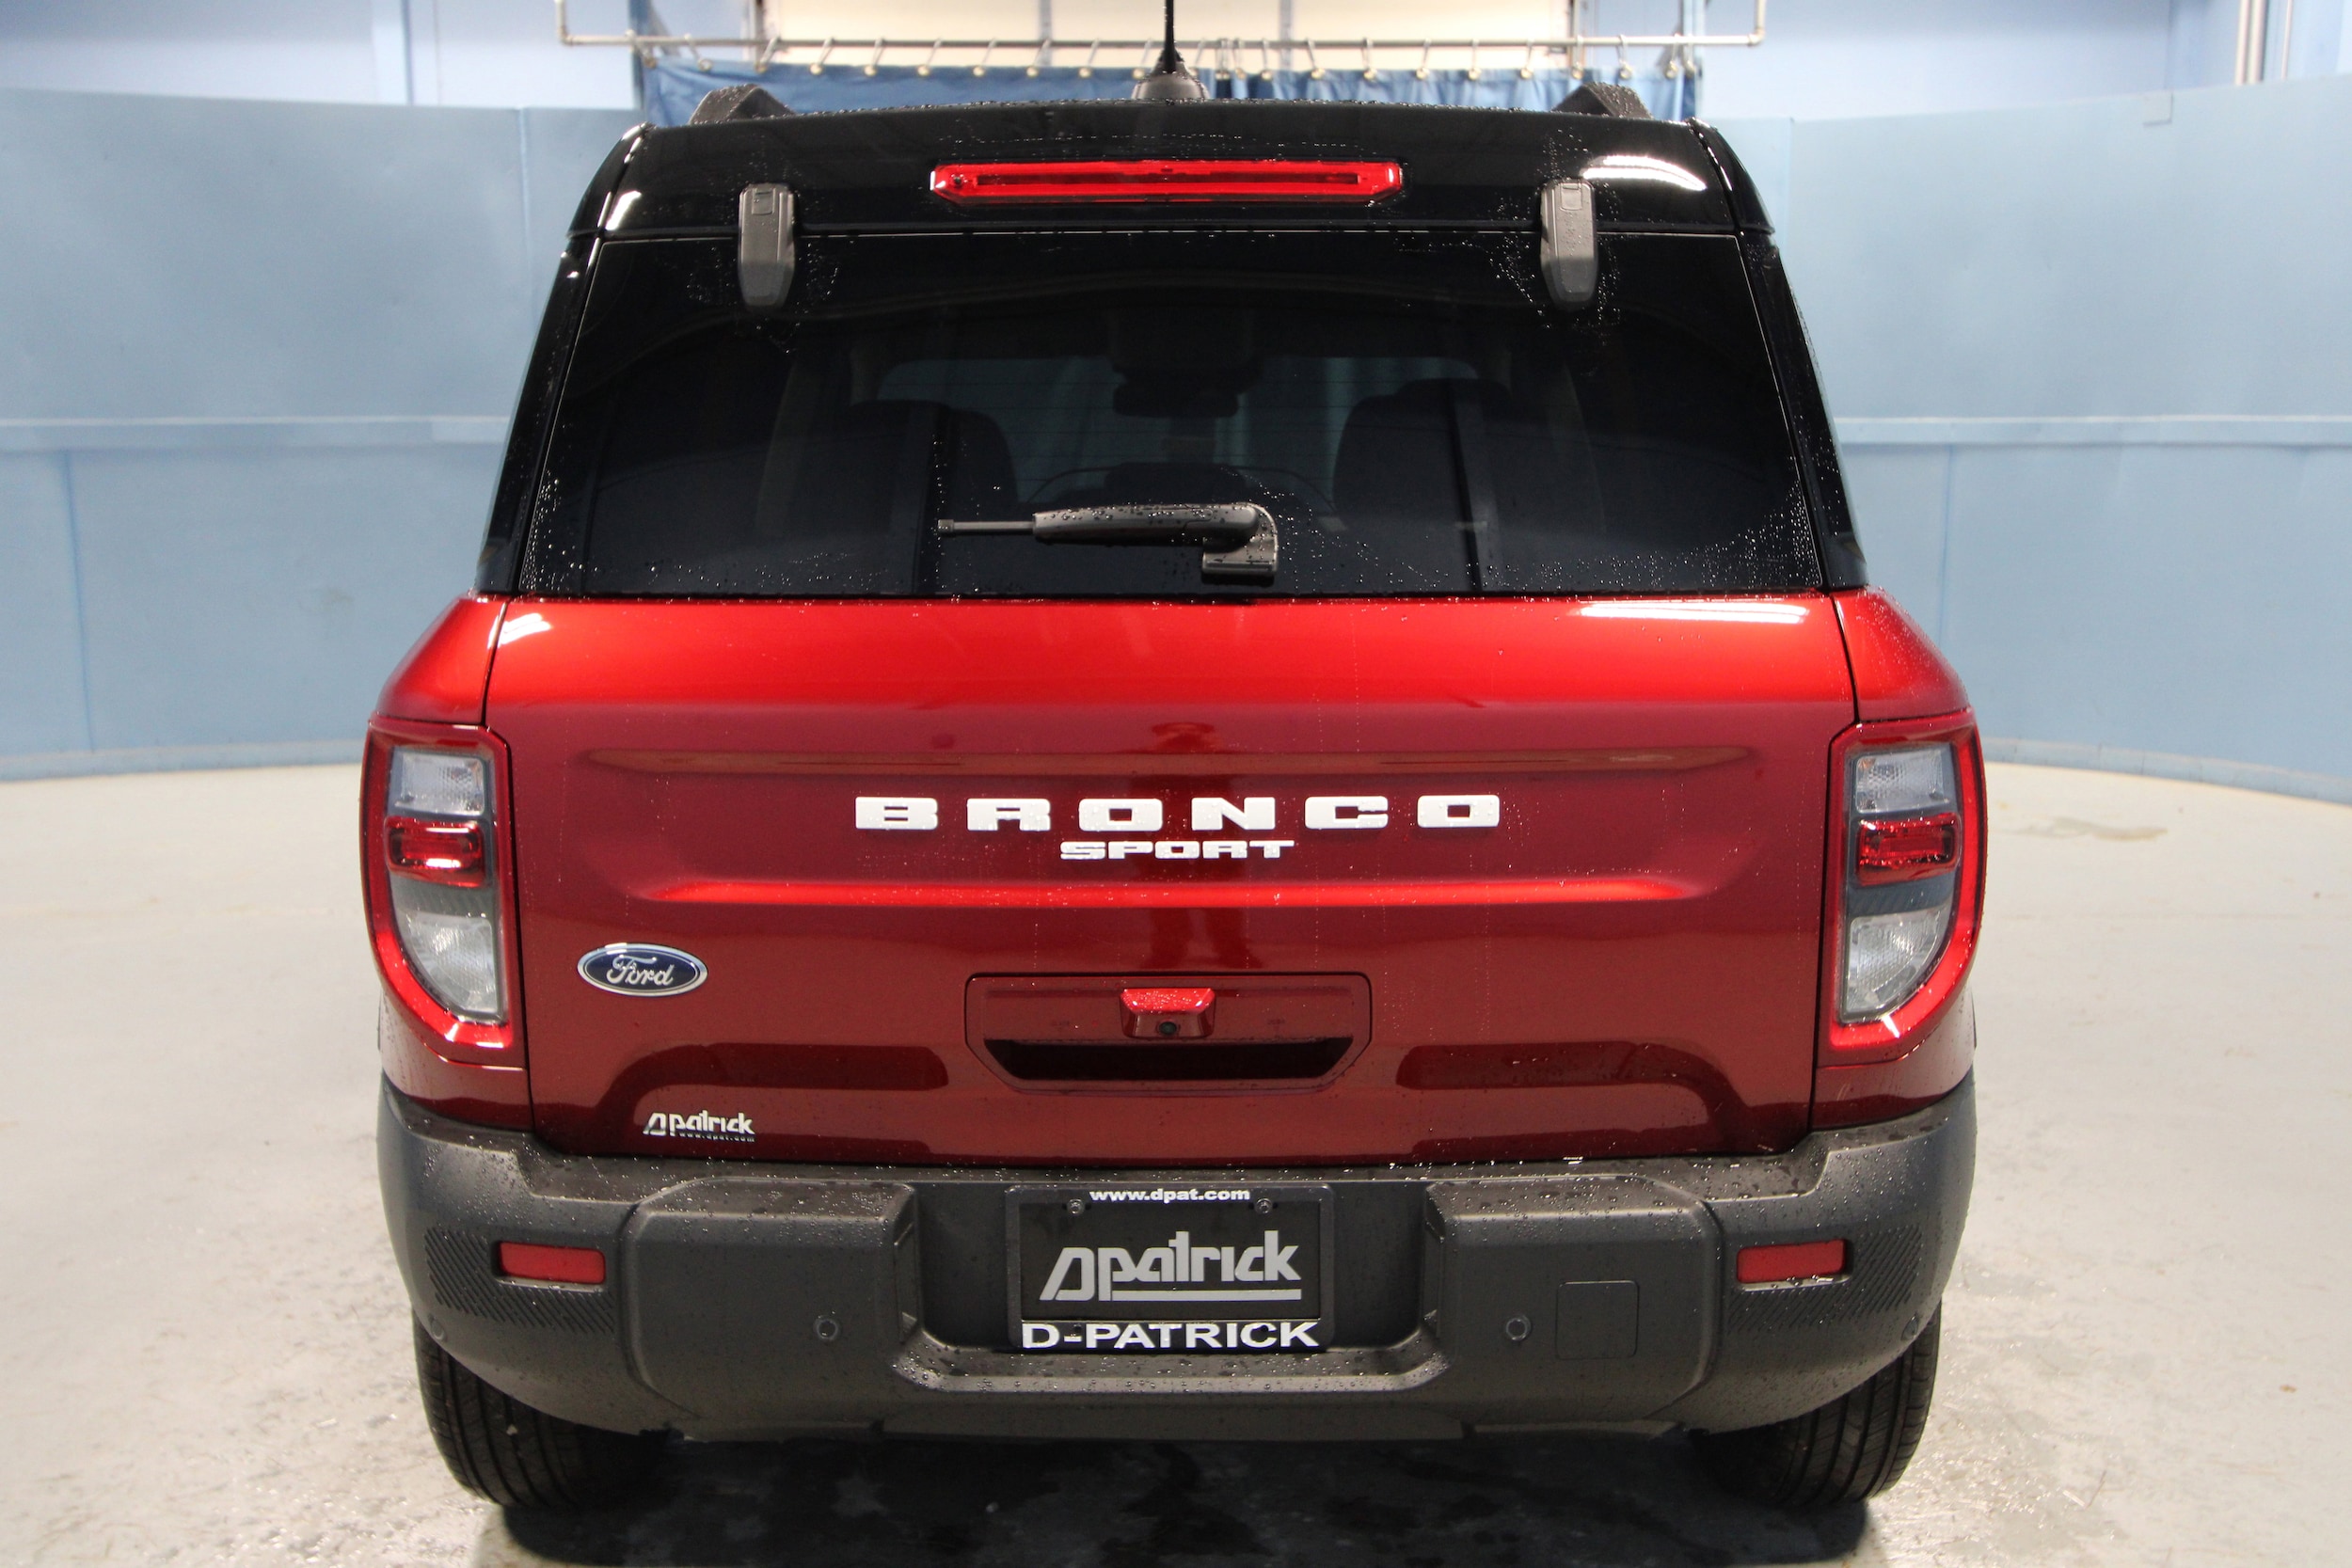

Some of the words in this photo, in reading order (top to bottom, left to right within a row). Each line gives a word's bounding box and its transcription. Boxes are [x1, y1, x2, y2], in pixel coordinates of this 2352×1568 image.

[854, 796, 1501, 831] BRONCO
[1059, 840, 1294, 860] SPORT
[606, 955, 674, 985] Ford
[1089, 1188, 1250, 1203] www.dpat.com
[1022, 1323, 1319, 1349] D-PATRICK
